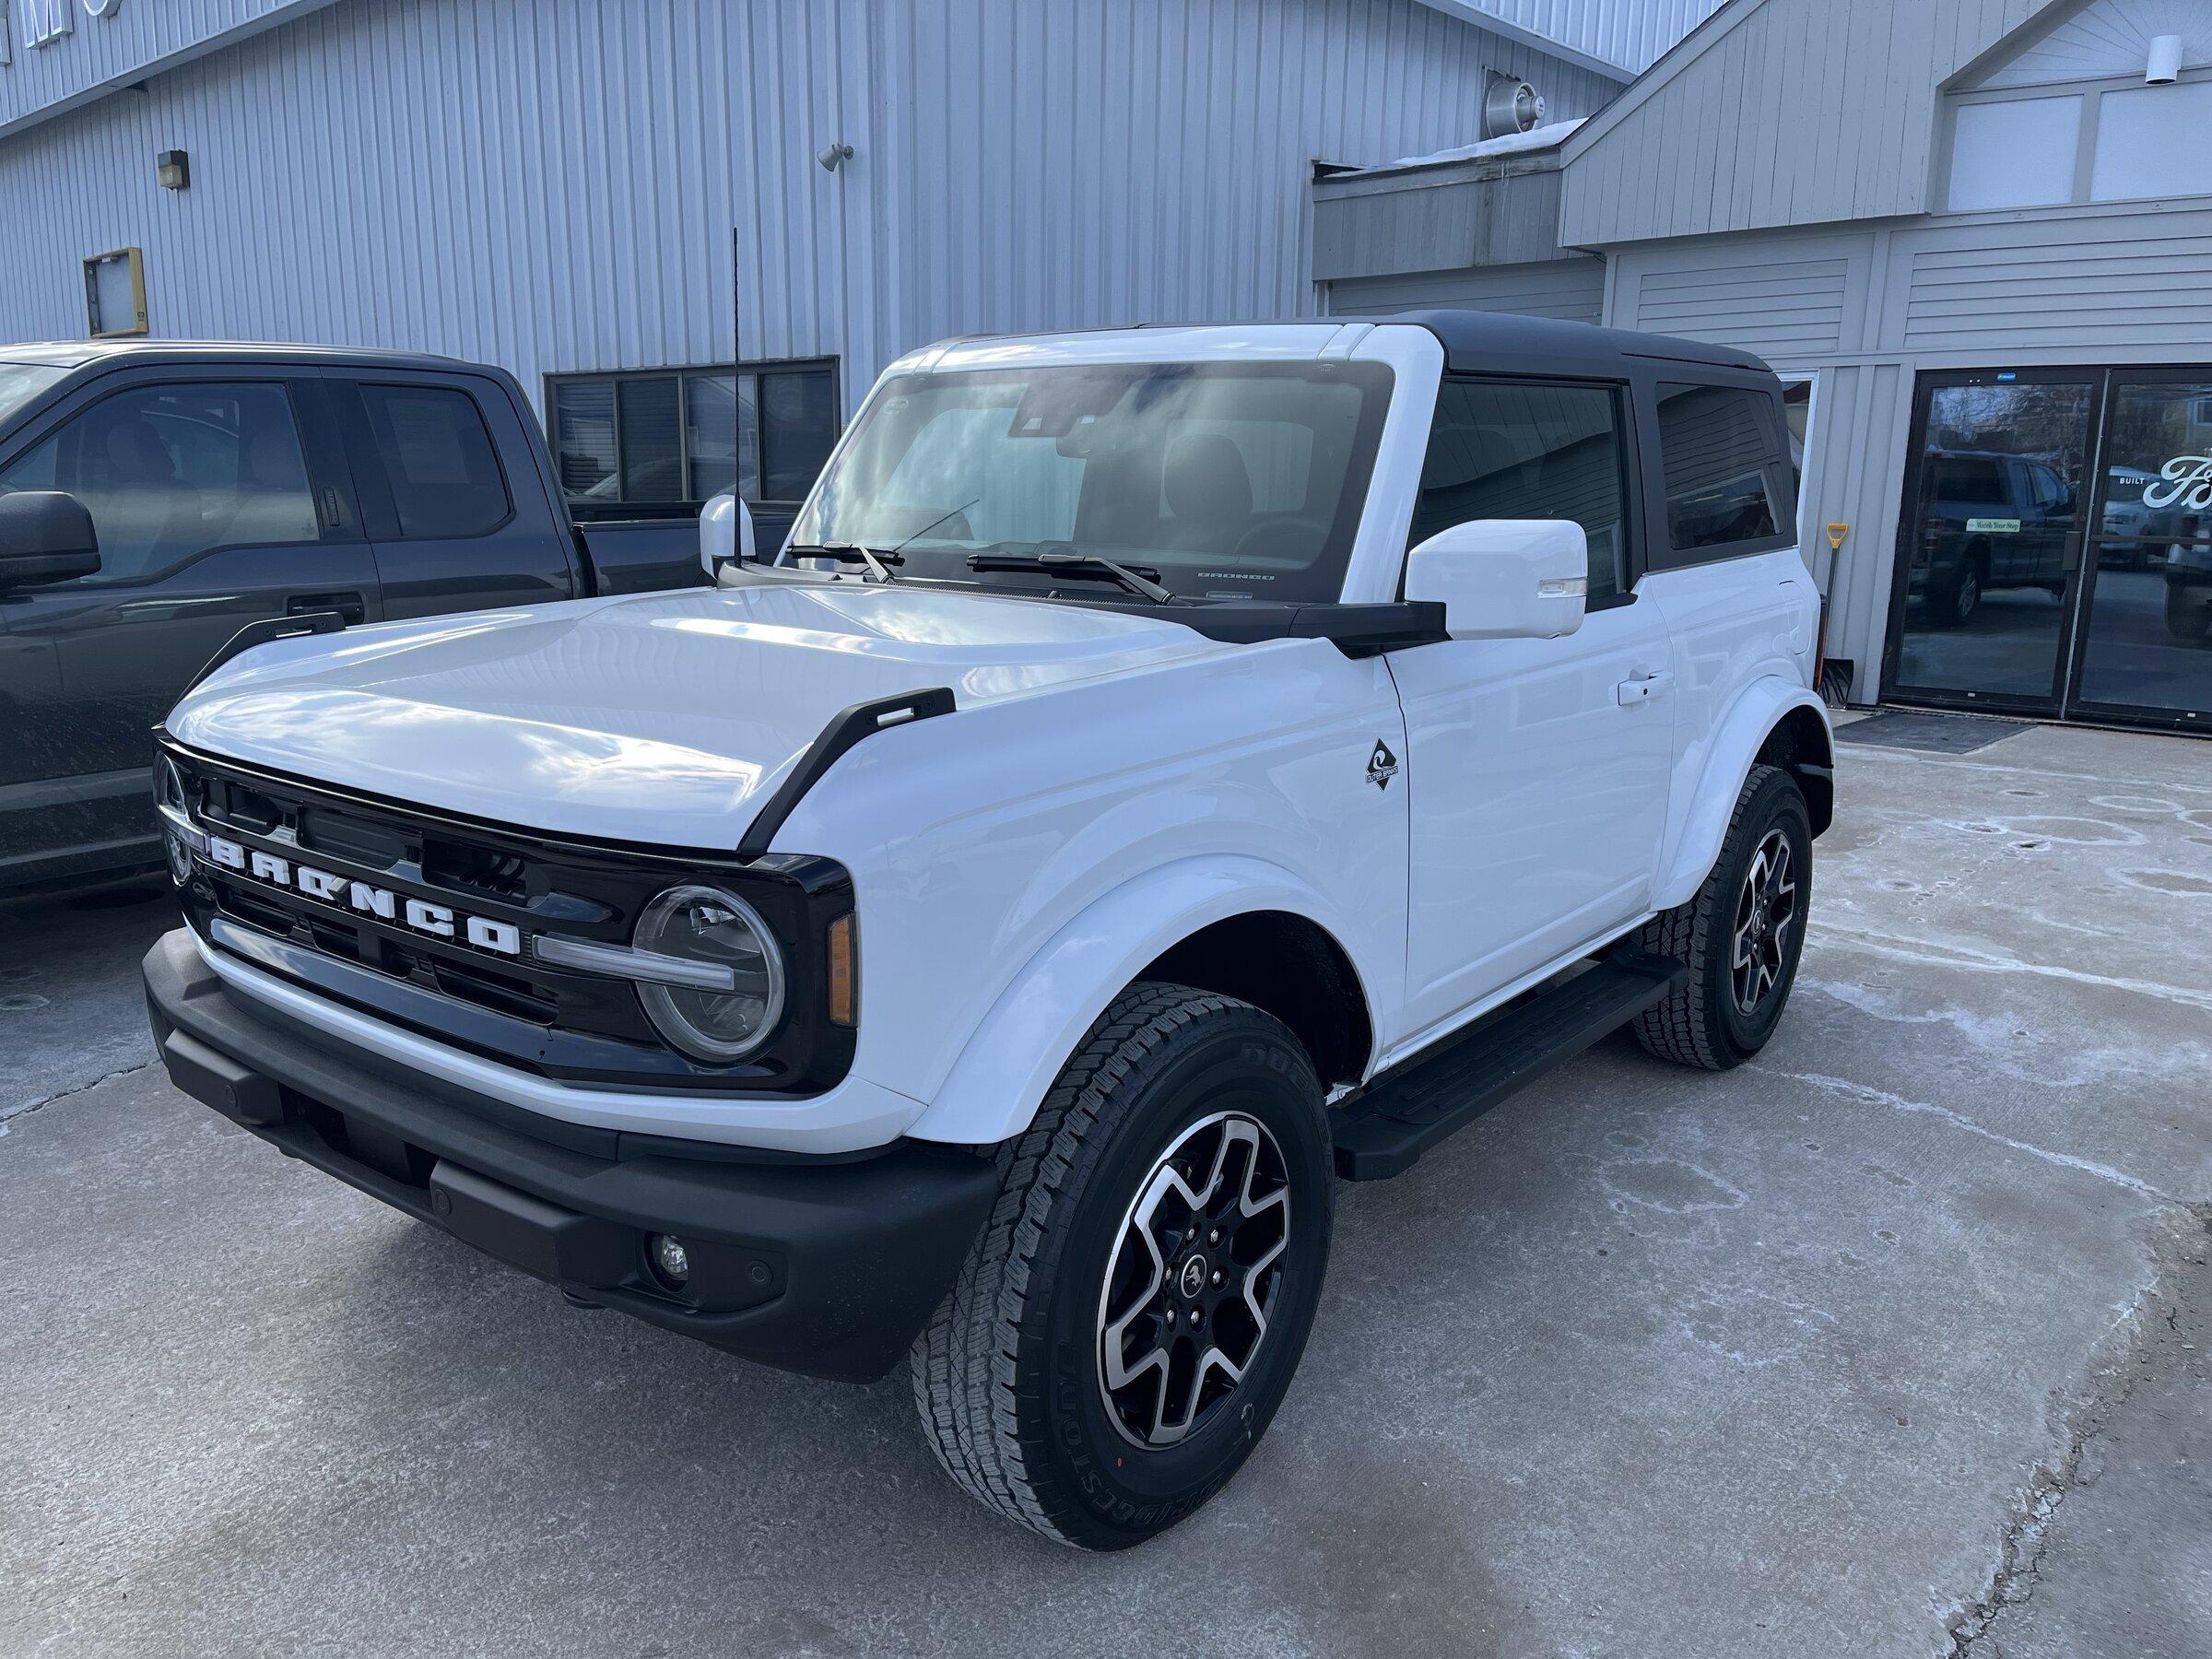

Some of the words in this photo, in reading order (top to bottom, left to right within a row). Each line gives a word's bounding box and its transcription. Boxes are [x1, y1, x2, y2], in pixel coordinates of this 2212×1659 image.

[1976, 521, 1993, 529] Watch
[1994, 521, 2006, 529] Your
[1197, 571, 1276, 582] BRONCO
[210, 835, 521, 955] BRONCO
